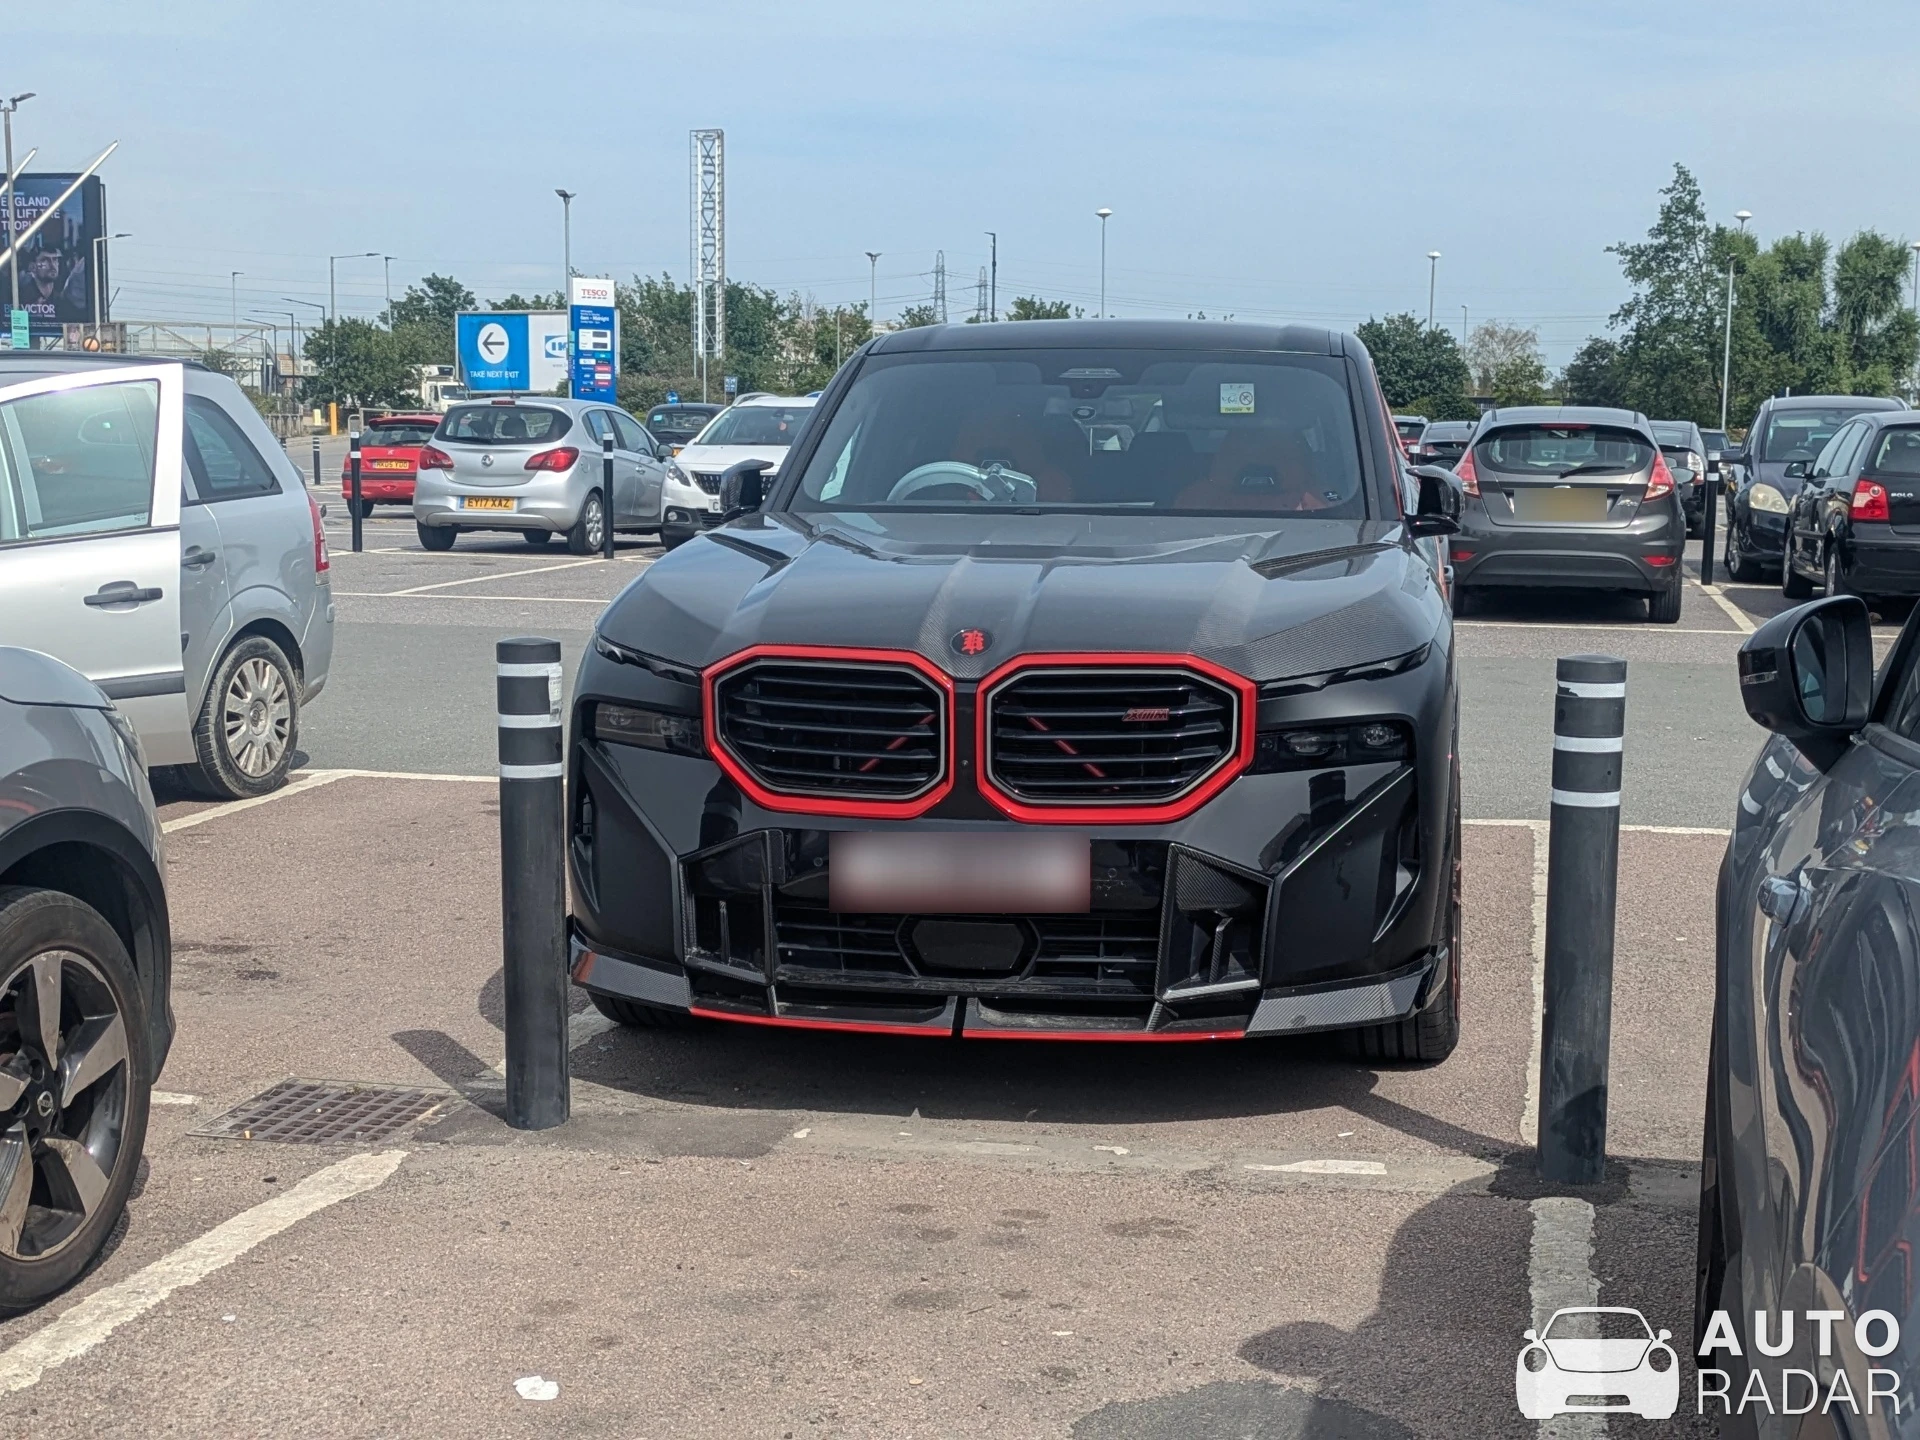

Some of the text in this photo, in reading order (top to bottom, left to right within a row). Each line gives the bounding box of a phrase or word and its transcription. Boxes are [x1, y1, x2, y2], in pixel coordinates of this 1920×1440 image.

[1, 197, 51, 206] EGLAND
[17, 209, 38, 218] LIFT
[581, 289, 608, 297] TESCO
[469, 370, 520, 379] TAKE NEXT EXIT
[467, 497, 510, 508] EY17 XAZ
